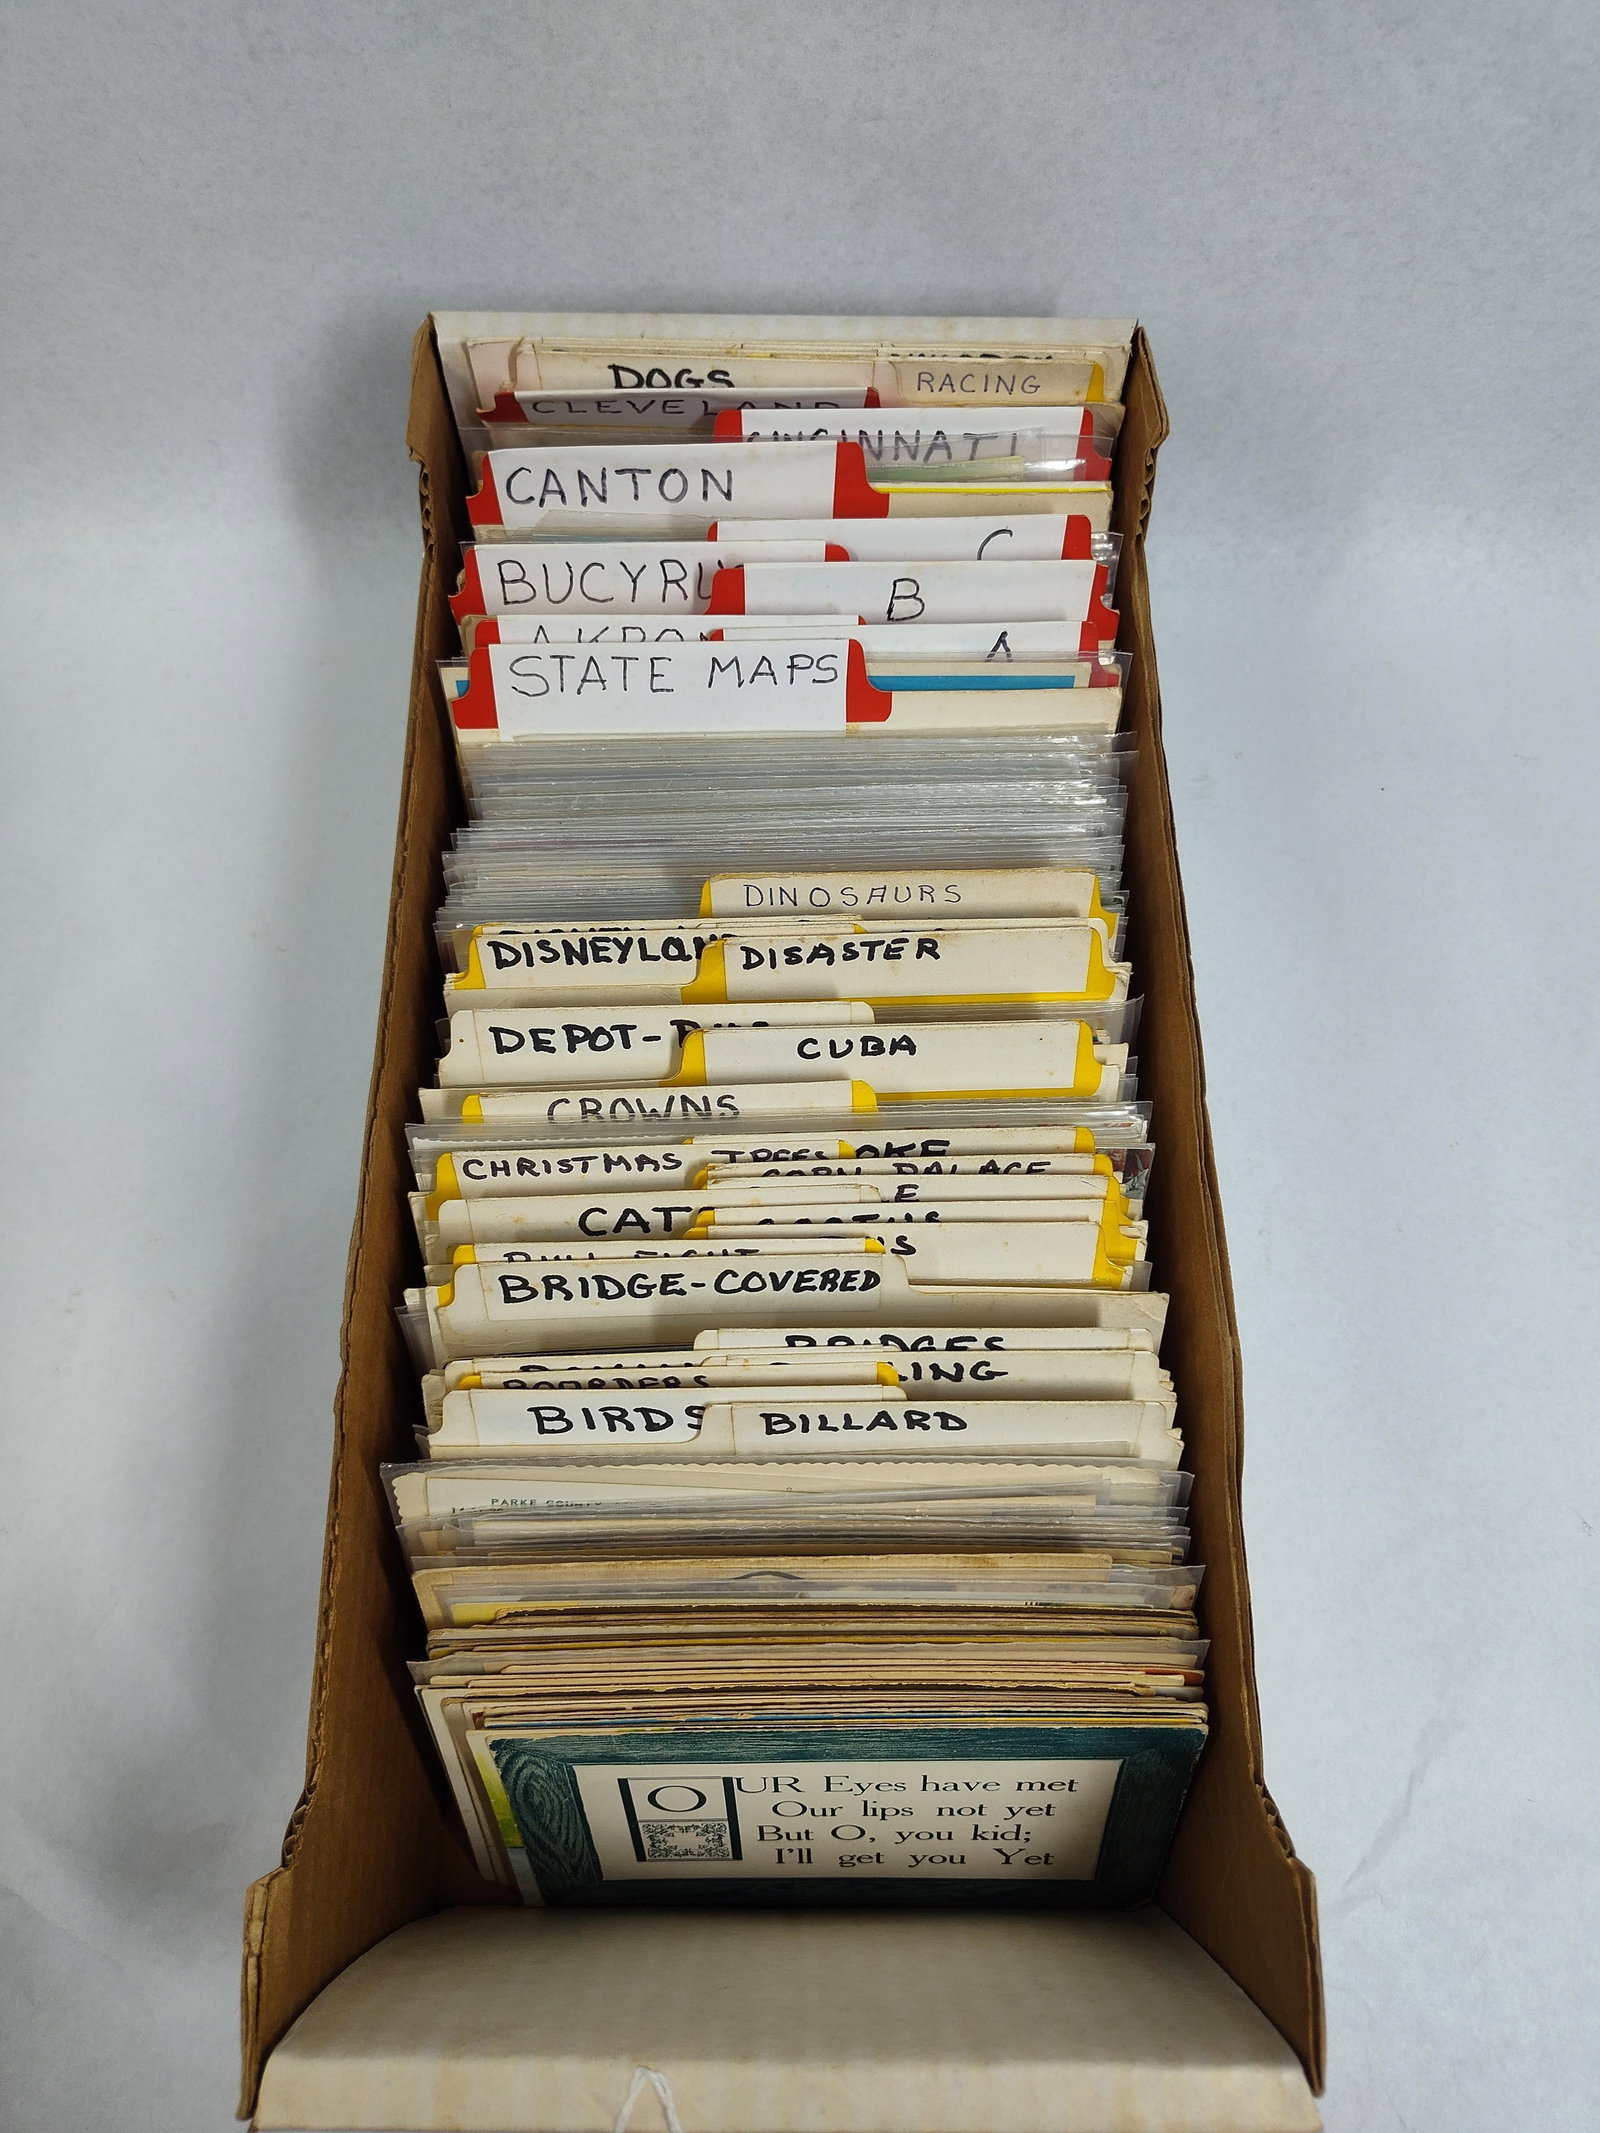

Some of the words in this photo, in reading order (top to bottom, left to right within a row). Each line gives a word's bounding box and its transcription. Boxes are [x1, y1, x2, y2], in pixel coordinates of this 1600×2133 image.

[608, 364, 735, 388] DOGS
[917, 371, 1041, 396] RACING
[505, 466, 734, 508] CANTON
[497, 559, 743, 605] BUCYRU
[885, 577, 926, 622] B
[508, 654, 675, 698] STATE
[707, 653, 840, 689] MAPS
[743, 884, 962, 908] DINOSAURS
[739, 937, 942, 970] DISASTER
[796, 1034, 917, 1059] CUBA
[547, 1094, 740, 1123] CROWNS
[855, 1139, 950, 1158] OKE
[462, 1152, 683, 1181] CHRISTMAS
[578, 1206, 714, 1237] CAT
[784, 1333, 1007, 1351] BDGES
[526, 1404, 706, 1435] BIRDS
[759, 1410, 968, 1436] BILLARD
[823, 1775, 907, 1796] Eyes
[920, 1774, 1000, 1792] have
[1015, 1778, 1079, 1792] met
[771, 1800, 844, 1818] Our
[861, 1800, 914, 1820] lips
[936, 1803, 988, 1817] not
[1003, 1803, 1056, 1820] yet
[757, 1824, 814, 1842] But
[830, 1824, 877, 1843] O,
[894, 1829, 953, 1845] you
[970, 1824, 1032, 1844] kid;
[838, 1851, 885, 1868] get
[908, 1851, 966, 1868] you
[992, 1847, 1055, 1865] Yet
